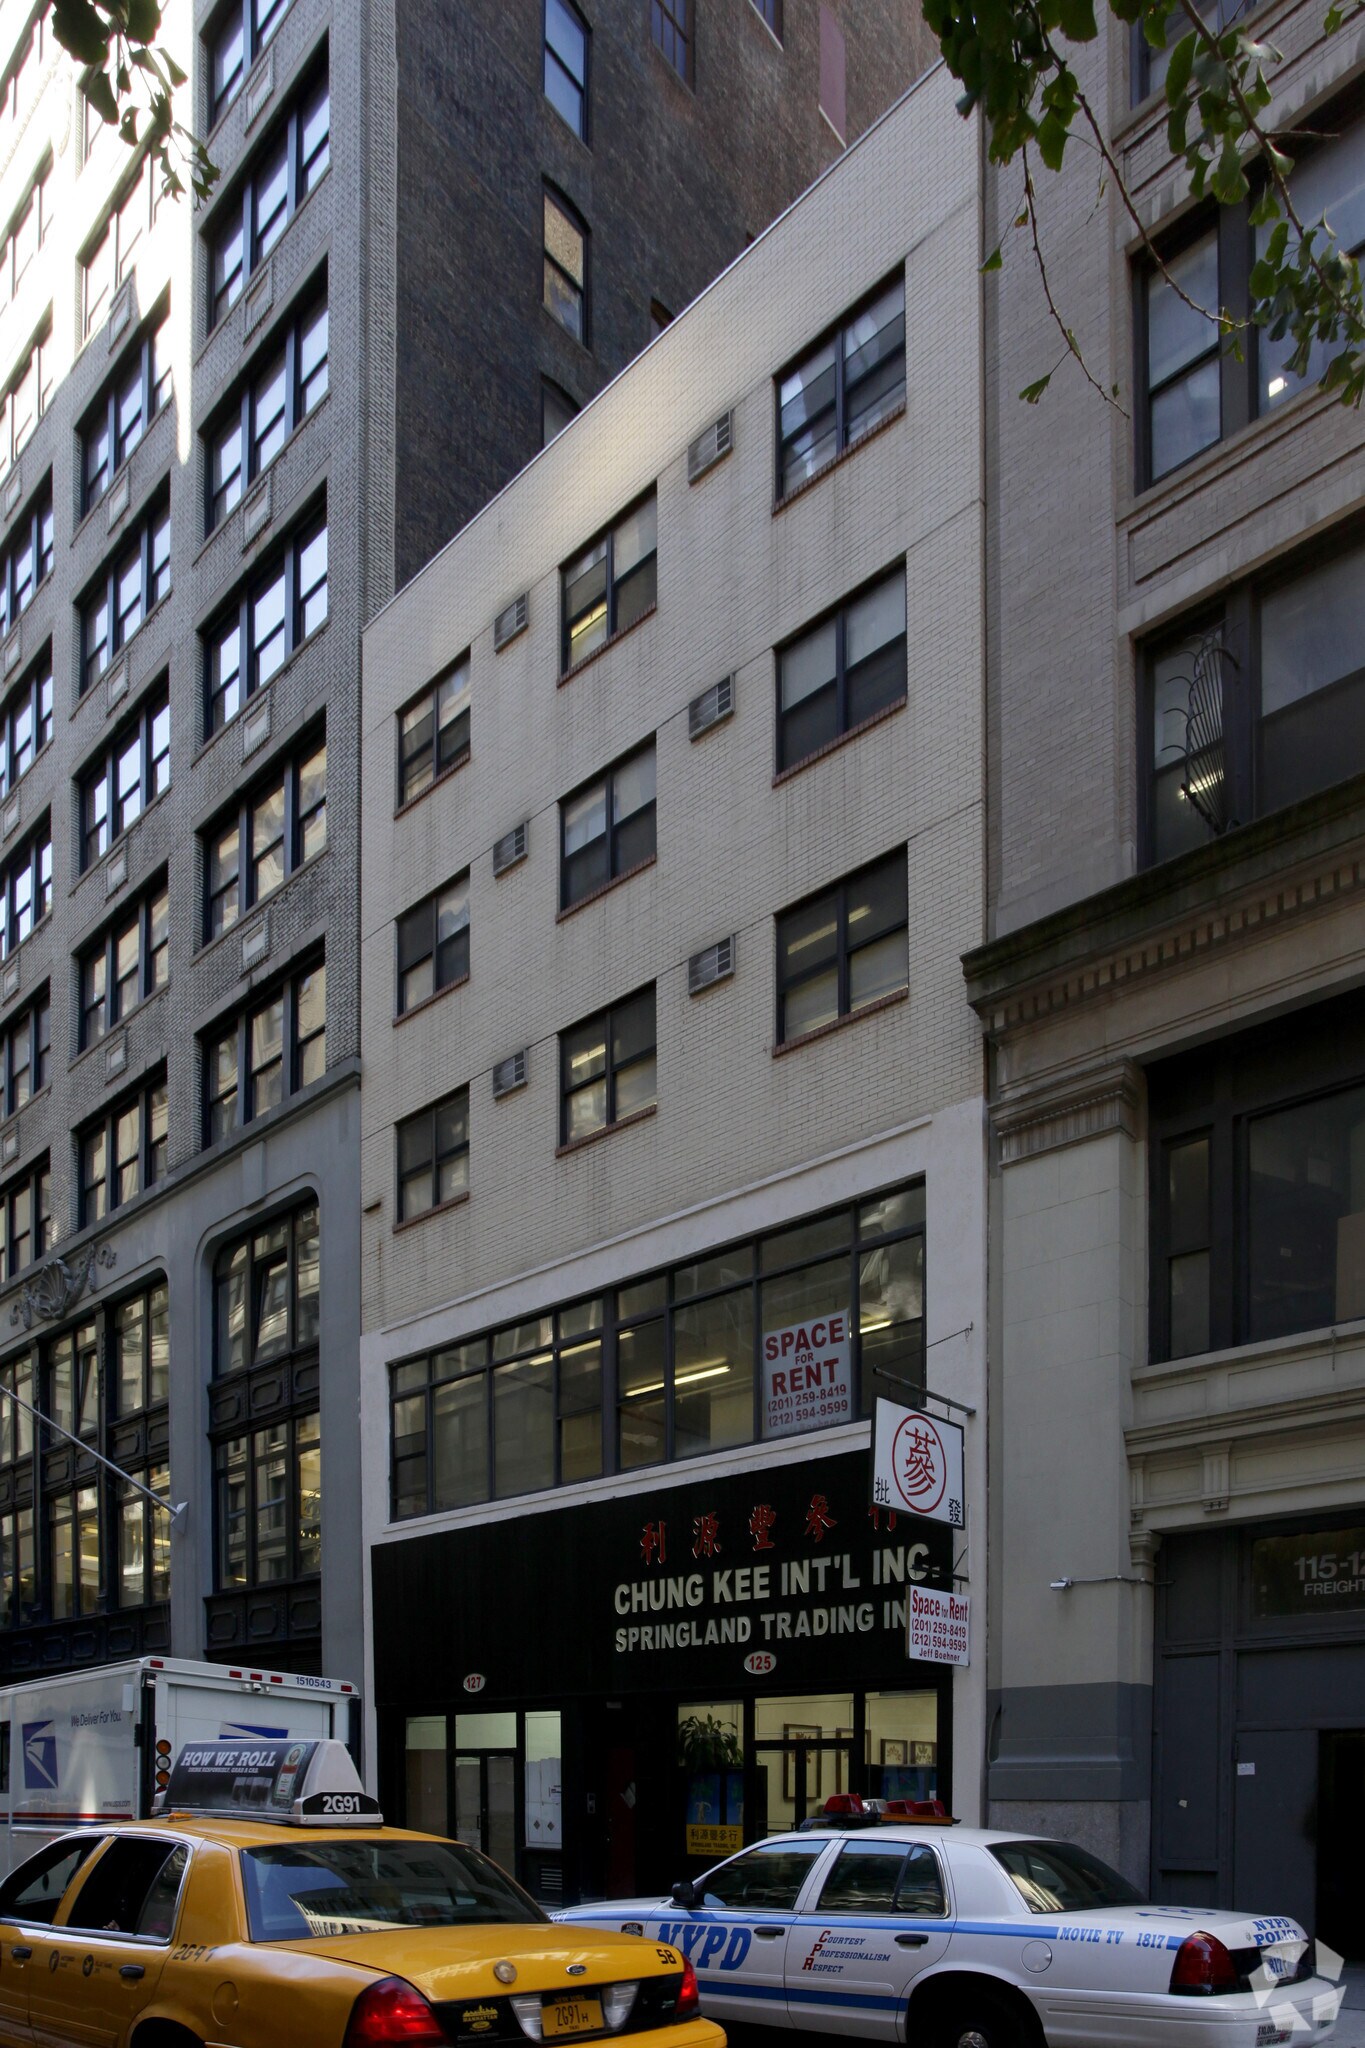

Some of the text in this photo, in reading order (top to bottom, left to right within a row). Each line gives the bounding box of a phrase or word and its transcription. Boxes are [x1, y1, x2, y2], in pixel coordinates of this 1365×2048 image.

[765, 1317, 845, 1361] SPACE
[795, 1352, 814, 1365] FOR
[772, 1358, 839, 1397] RENT
[768, 1384, 847, 1413] (201) 259-8419
[769, 1399, 848, 1428] (212) 594-9599
[875, 1477, 890, 1504] 批
[614, 1573, 704, 1615] CHUNG
[713, 1566, 770, 1603] KEE
[781, 1553, 861, 1596] INT'L
[912, 1589, 940, 1617] Space
[949, 1596, 968, 1622] Rent
[615, 1599, 907, 1653] SPRINGLAND TRADING IN
[912, 1618, 967, 1638] (201) 259-8419
[912, 1633, 967, 1652] (212) 594-9599
[749, 1655, 772, 1671] 125
[919, 1647, 960, 1661] Jeff Boehner
[295, 1676, 332, 1689] 1510543
[466, 1675, 482, 1690] 127
[71, 1715, 80, 1727] We
[80, 1713, 99, 1726] Deliver
[99, 1711, 109, 1724] For
[180, 1750, 277, 1767] HOW WE ROLL
[322, 1795, 361, 1813] 2G91
[1252, 1917, 1290, 1931] NYPD
[658, 1923, 752, 1971] NYPD
[1059, 1926, 1167, 1949] MOVIE TV 1817
[1253, 1929, 1300, 1947] POLICE
[172, 1943, 220, 1962] 2G91
